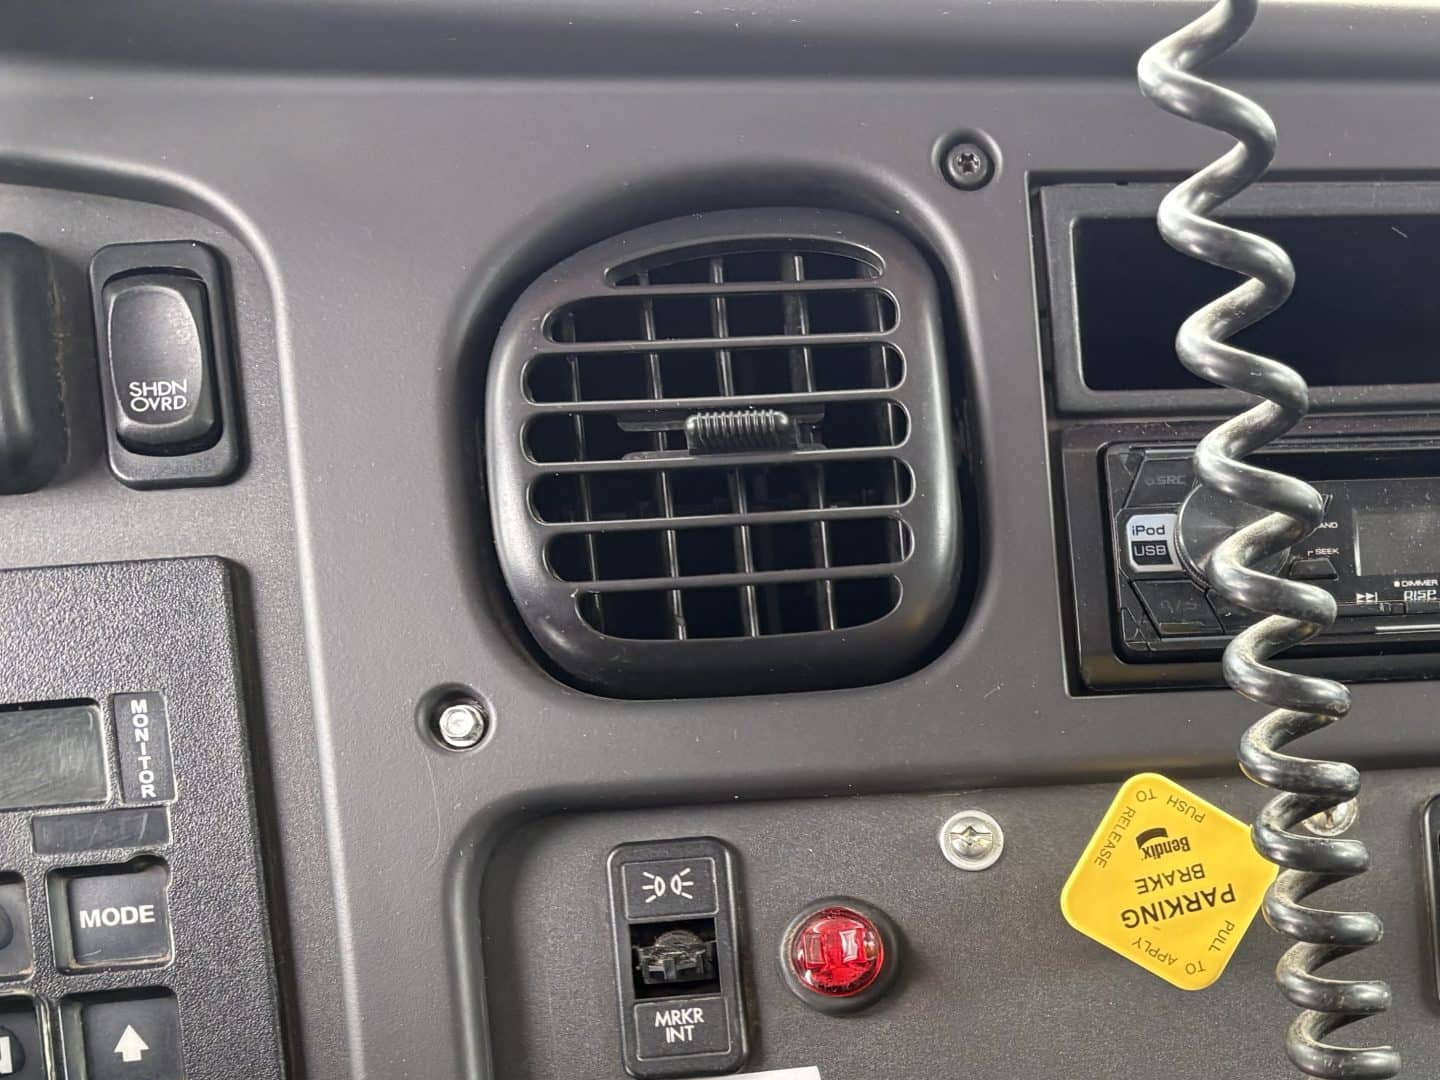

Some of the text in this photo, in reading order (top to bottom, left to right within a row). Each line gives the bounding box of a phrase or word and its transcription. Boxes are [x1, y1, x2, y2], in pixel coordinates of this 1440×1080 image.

[129, 379, 187, 398] SHDN
[130, 395, 187, 412] OVRD
[1131, 524, 1166, 536] iPod
[1318, 521, 1338, 529] AND
[1134, 544, 1167, 557] USB
[1315, 547, 1340, 556] SEEK
[1401, 579, 1439, 588] DIMMER
[130, 699, 156, 798] MONITOR
[1093, 788, 1207, 869] PUSH TO RELEASE
[1142, 836, 1191, 860] Bendix
[1134, 863, 1206, 895] BRAKE
[1120, 883, 1237, 929] PARKING
[79, 904, 156, 929] MODE
[1131, 920, 1236, 976] PULL TO APPLY
[654, 1008, 704, 1028] MRKR
[665, 1026, 695, 1043] INT
